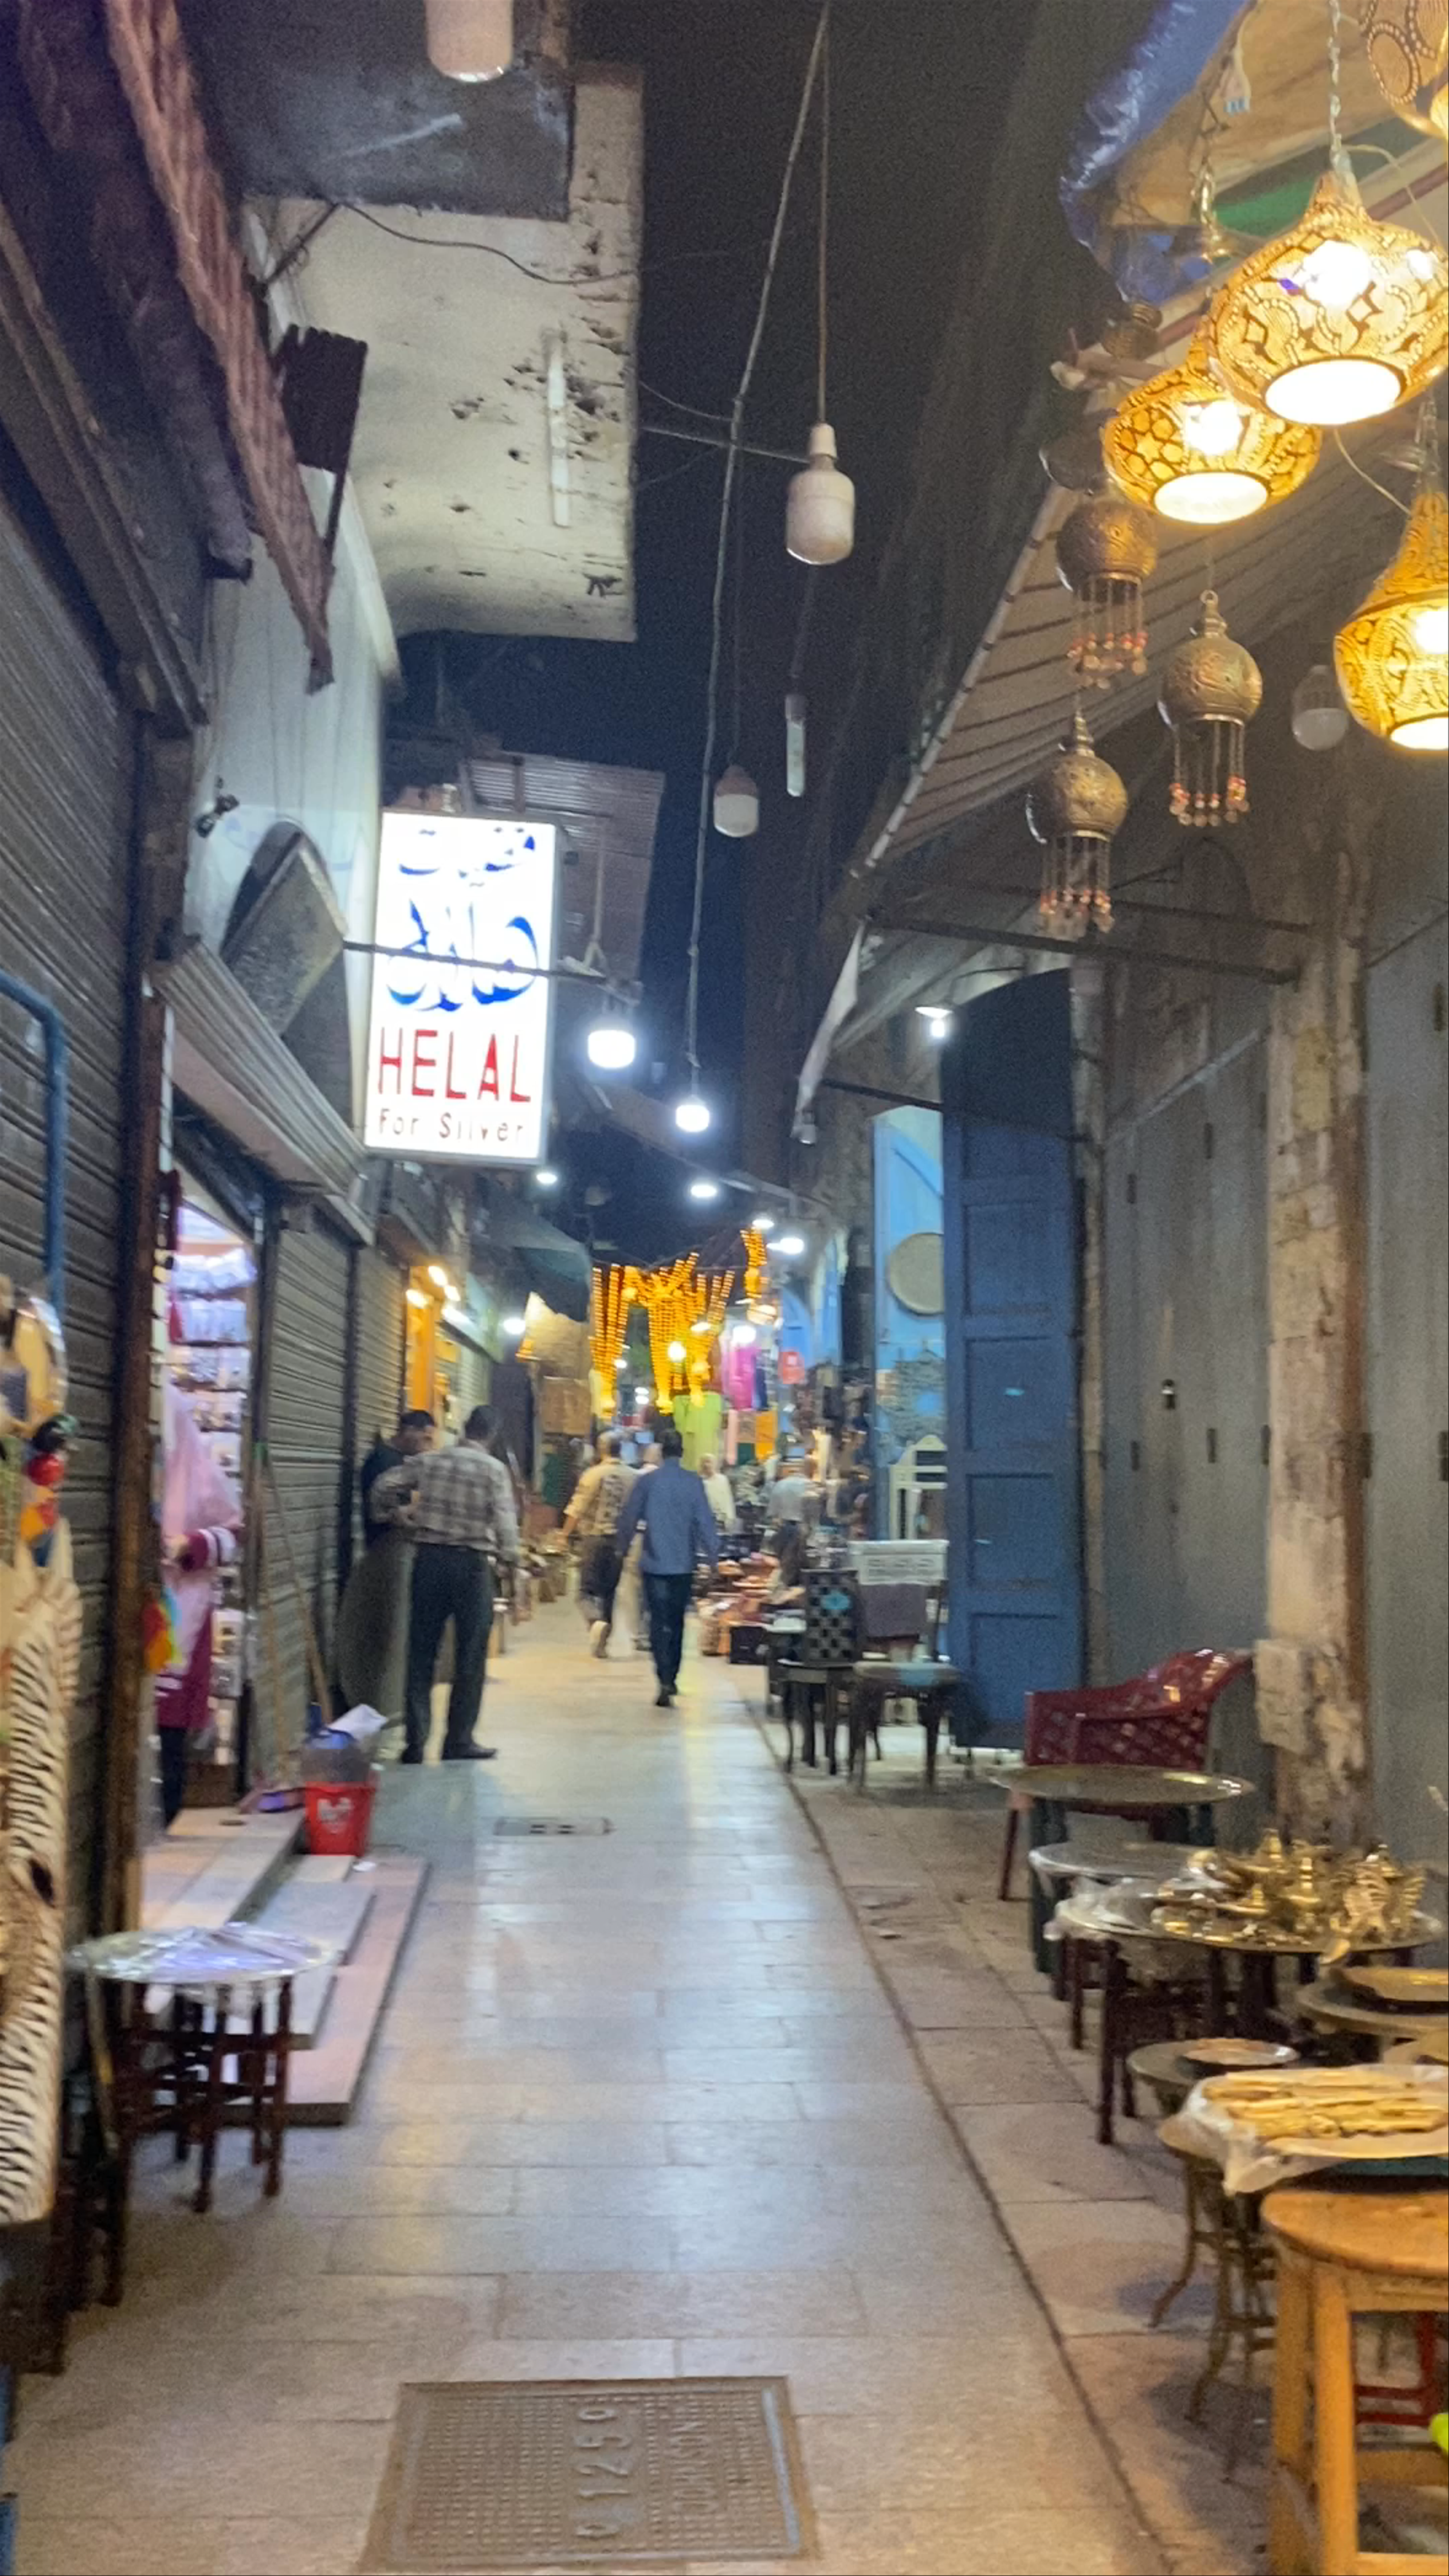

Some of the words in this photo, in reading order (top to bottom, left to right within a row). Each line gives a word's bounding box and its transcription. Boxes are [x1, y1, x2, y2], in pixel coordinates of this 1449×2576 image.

[377, 1027, 532, 1103] HELAL
[378, 1107, 421, 1137] For
[438, 1111, 525, 1143] Silver
